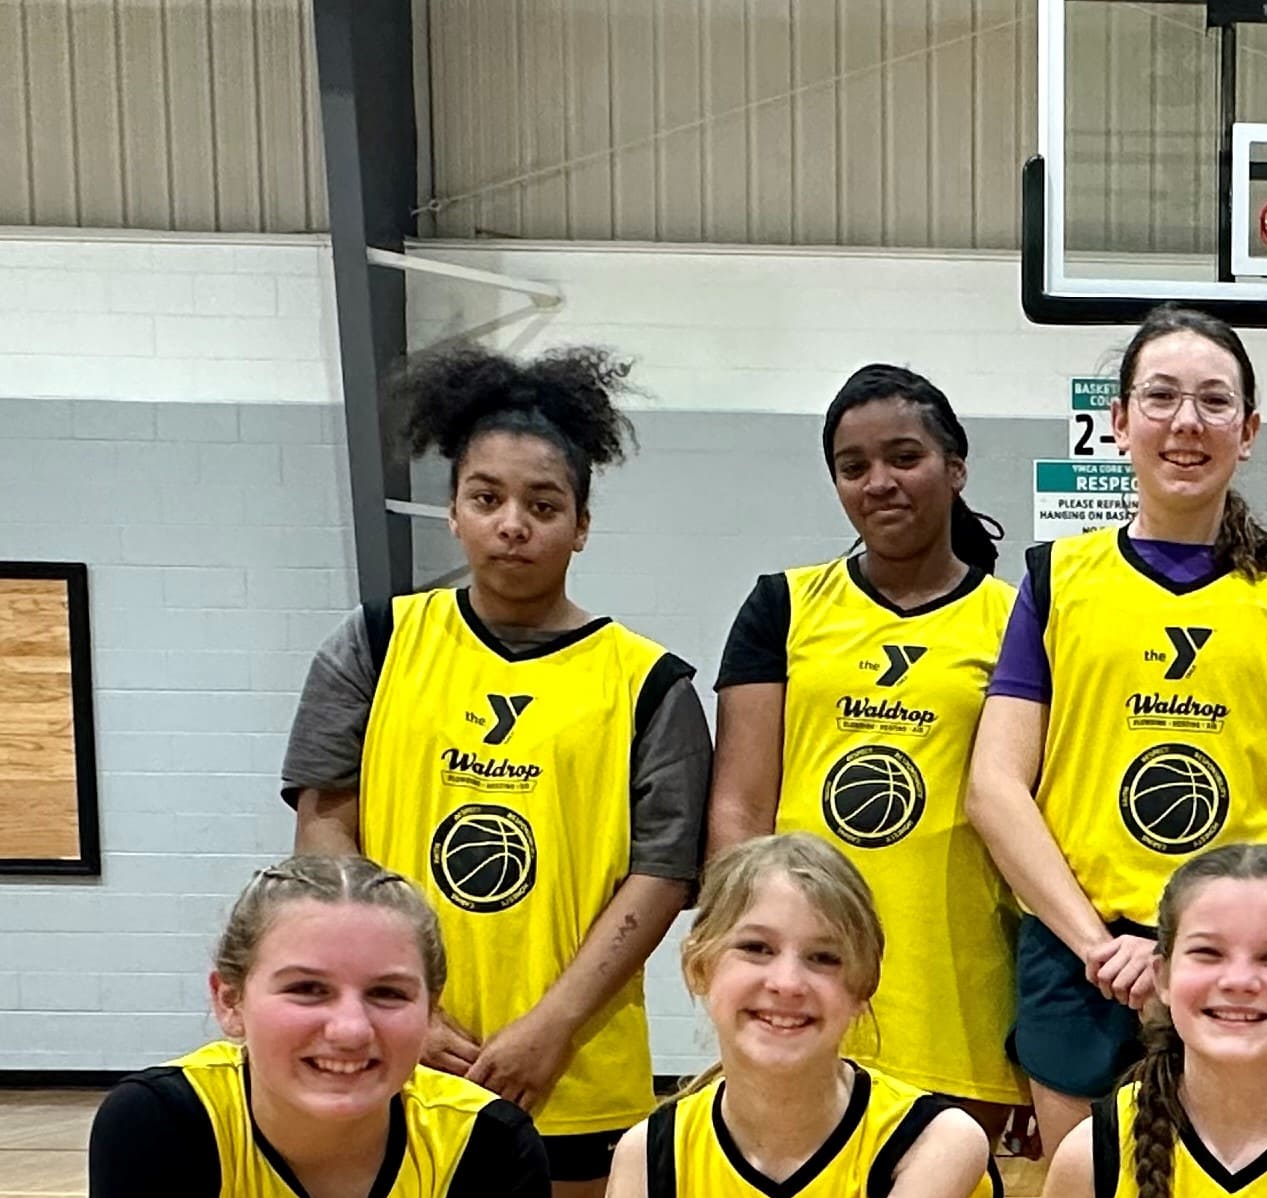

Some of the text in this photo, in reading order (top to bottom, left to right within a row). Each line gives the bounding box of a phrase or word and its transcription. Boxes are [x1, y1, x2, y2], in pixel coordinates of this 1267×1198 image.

[1075, 383, 1120, 394] BASKET
[1076, 476, 1139, 491] RESPEC
[1058, 499, 1094, 508] PLEASE
[1040, 511, 1086, 520] HANGING
[1088, 511, 1103, 520] ON
[1144, 650, 1166, 662] the
[859, 660, 880, 671] the
[837, 696, 938, 725] Waldrop
[1125, 692, 1231, 721] Waldrop
[465, 711, 486, 726] the
[441, 748, 542, 781] Waldrop
